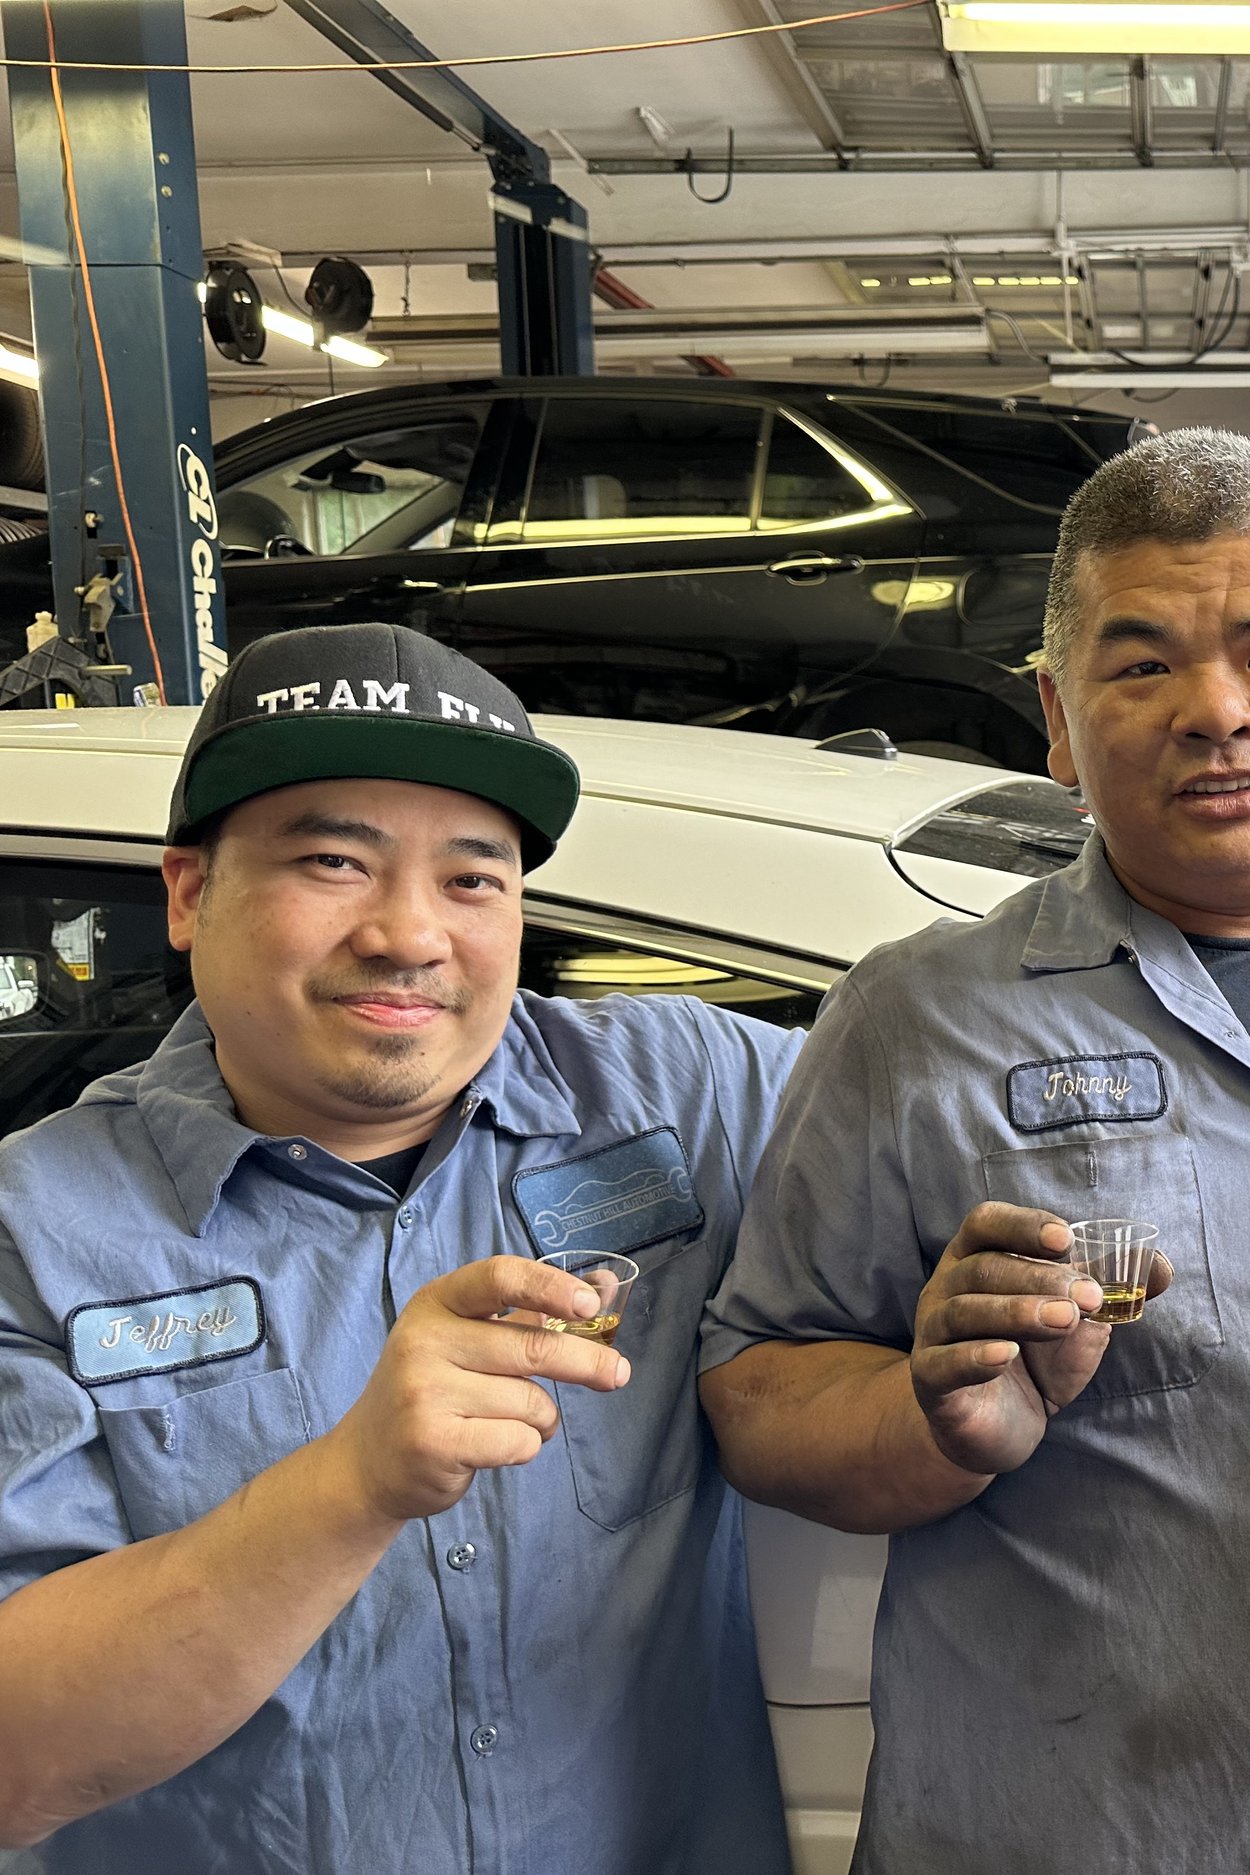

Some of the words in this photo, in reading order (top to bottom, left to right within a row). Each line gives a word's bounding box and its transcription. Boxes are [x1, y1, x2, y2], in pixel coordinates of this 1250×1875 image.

[191, 538, 229, 704] Challe
[257, 679, 410, 713] TEAM
[1043, 1071, 1132, 1101] Johnny
[561, 1212, 602, 1232] CHESTNUT
[603, 1205, 623, 1219] HILL
[623, 1184, 676, 1210] AUTOMOTIVE
[100, 1307, 237, 1354] Jeffrey
